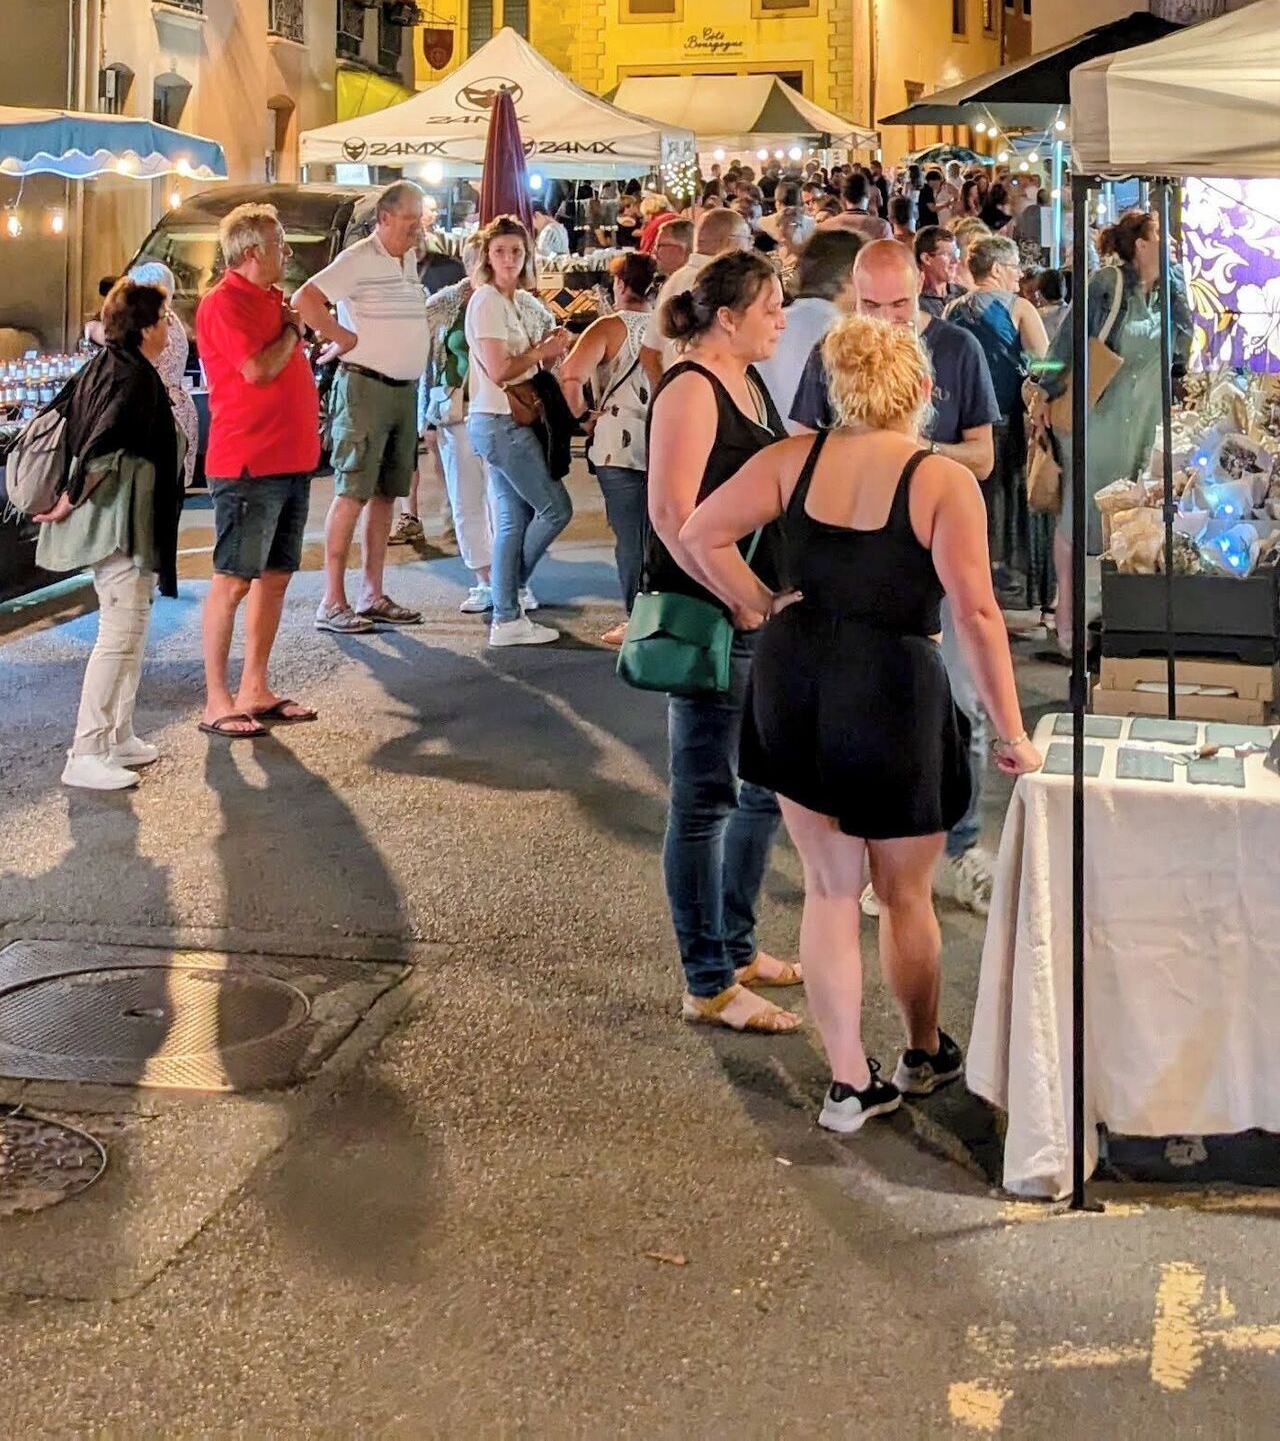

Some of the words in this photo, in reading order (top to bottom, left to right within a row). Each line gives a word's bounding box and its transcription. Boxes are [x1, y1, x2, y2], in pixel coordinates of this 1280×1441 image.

[684, 35, 743, 52] Bourgogne
[369, 141, 448, 155] 24MX
[538, 141, 618, 155] 24MX
